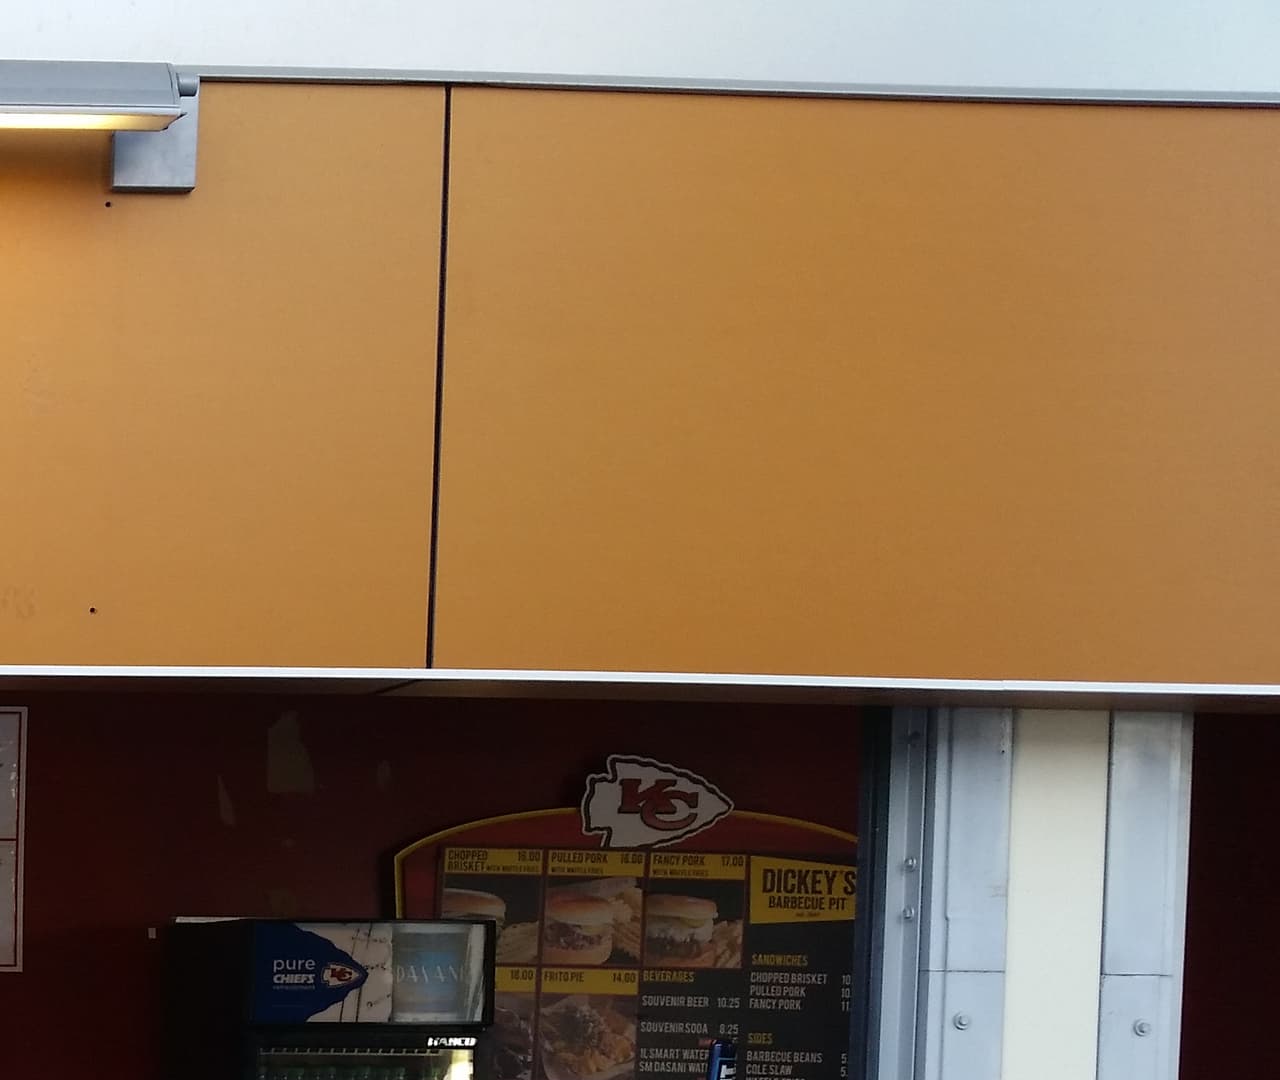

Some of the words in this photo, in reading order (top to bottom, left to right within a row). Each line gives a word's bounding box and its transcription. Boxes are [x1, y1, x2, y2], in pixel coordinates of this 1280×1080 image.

[448, 850, 488, 860] CHOPPED
[551, 852, 583, 863] PULLED
[584, 853, 608, 864] PORK
[653, 854, 681, 865] FANCY
[682, 855, 705, 866] PORK
[447, 860, 485, 871] BRISKET
[769, 896, 824, 910] BARBECUE
[829, 897, 847, 910] PIT
[272, 958, 316, 973] pure
[752, 953, 808, 966] SANDWICHES
[272, 974, 315, 984] CHIEFS
[544, 971, 568, 982] FRITO
[570, 972, 584, 983] PIE
[643, 971, 695, 982] BEVERAGES
[750, 972, 790, 984] CHOPPED
[791, 973, 827, 984] BRISKET
[750, 986, 782, 997] PULLED
[783, 986, 806, 997] PORK
[642, 995, 687, 1007] SOUVENIR
[688, 996, 710, 1007] BEER
[717, 997, 740, 1008] 10.25
[749, 999, 776, 1010] FANCY
[777, 999, 801, 1010] PORK
[640, 1022, 684, 1033] SOUVENIR
[684, 1022, 708, 1034] SODA
[747, 1033, 773, 1045] SIDES
[650, 1049, 680, 1060] SMART
[746, 1051, 792, 1063] BARBECUE
[793, 1052, 823, 1063] BEANS
[654, 1062, 686, 1073] DASANI
[746, 1064, 768, 1075] COLE
[769, 1064, 792, 1075] SLAW
